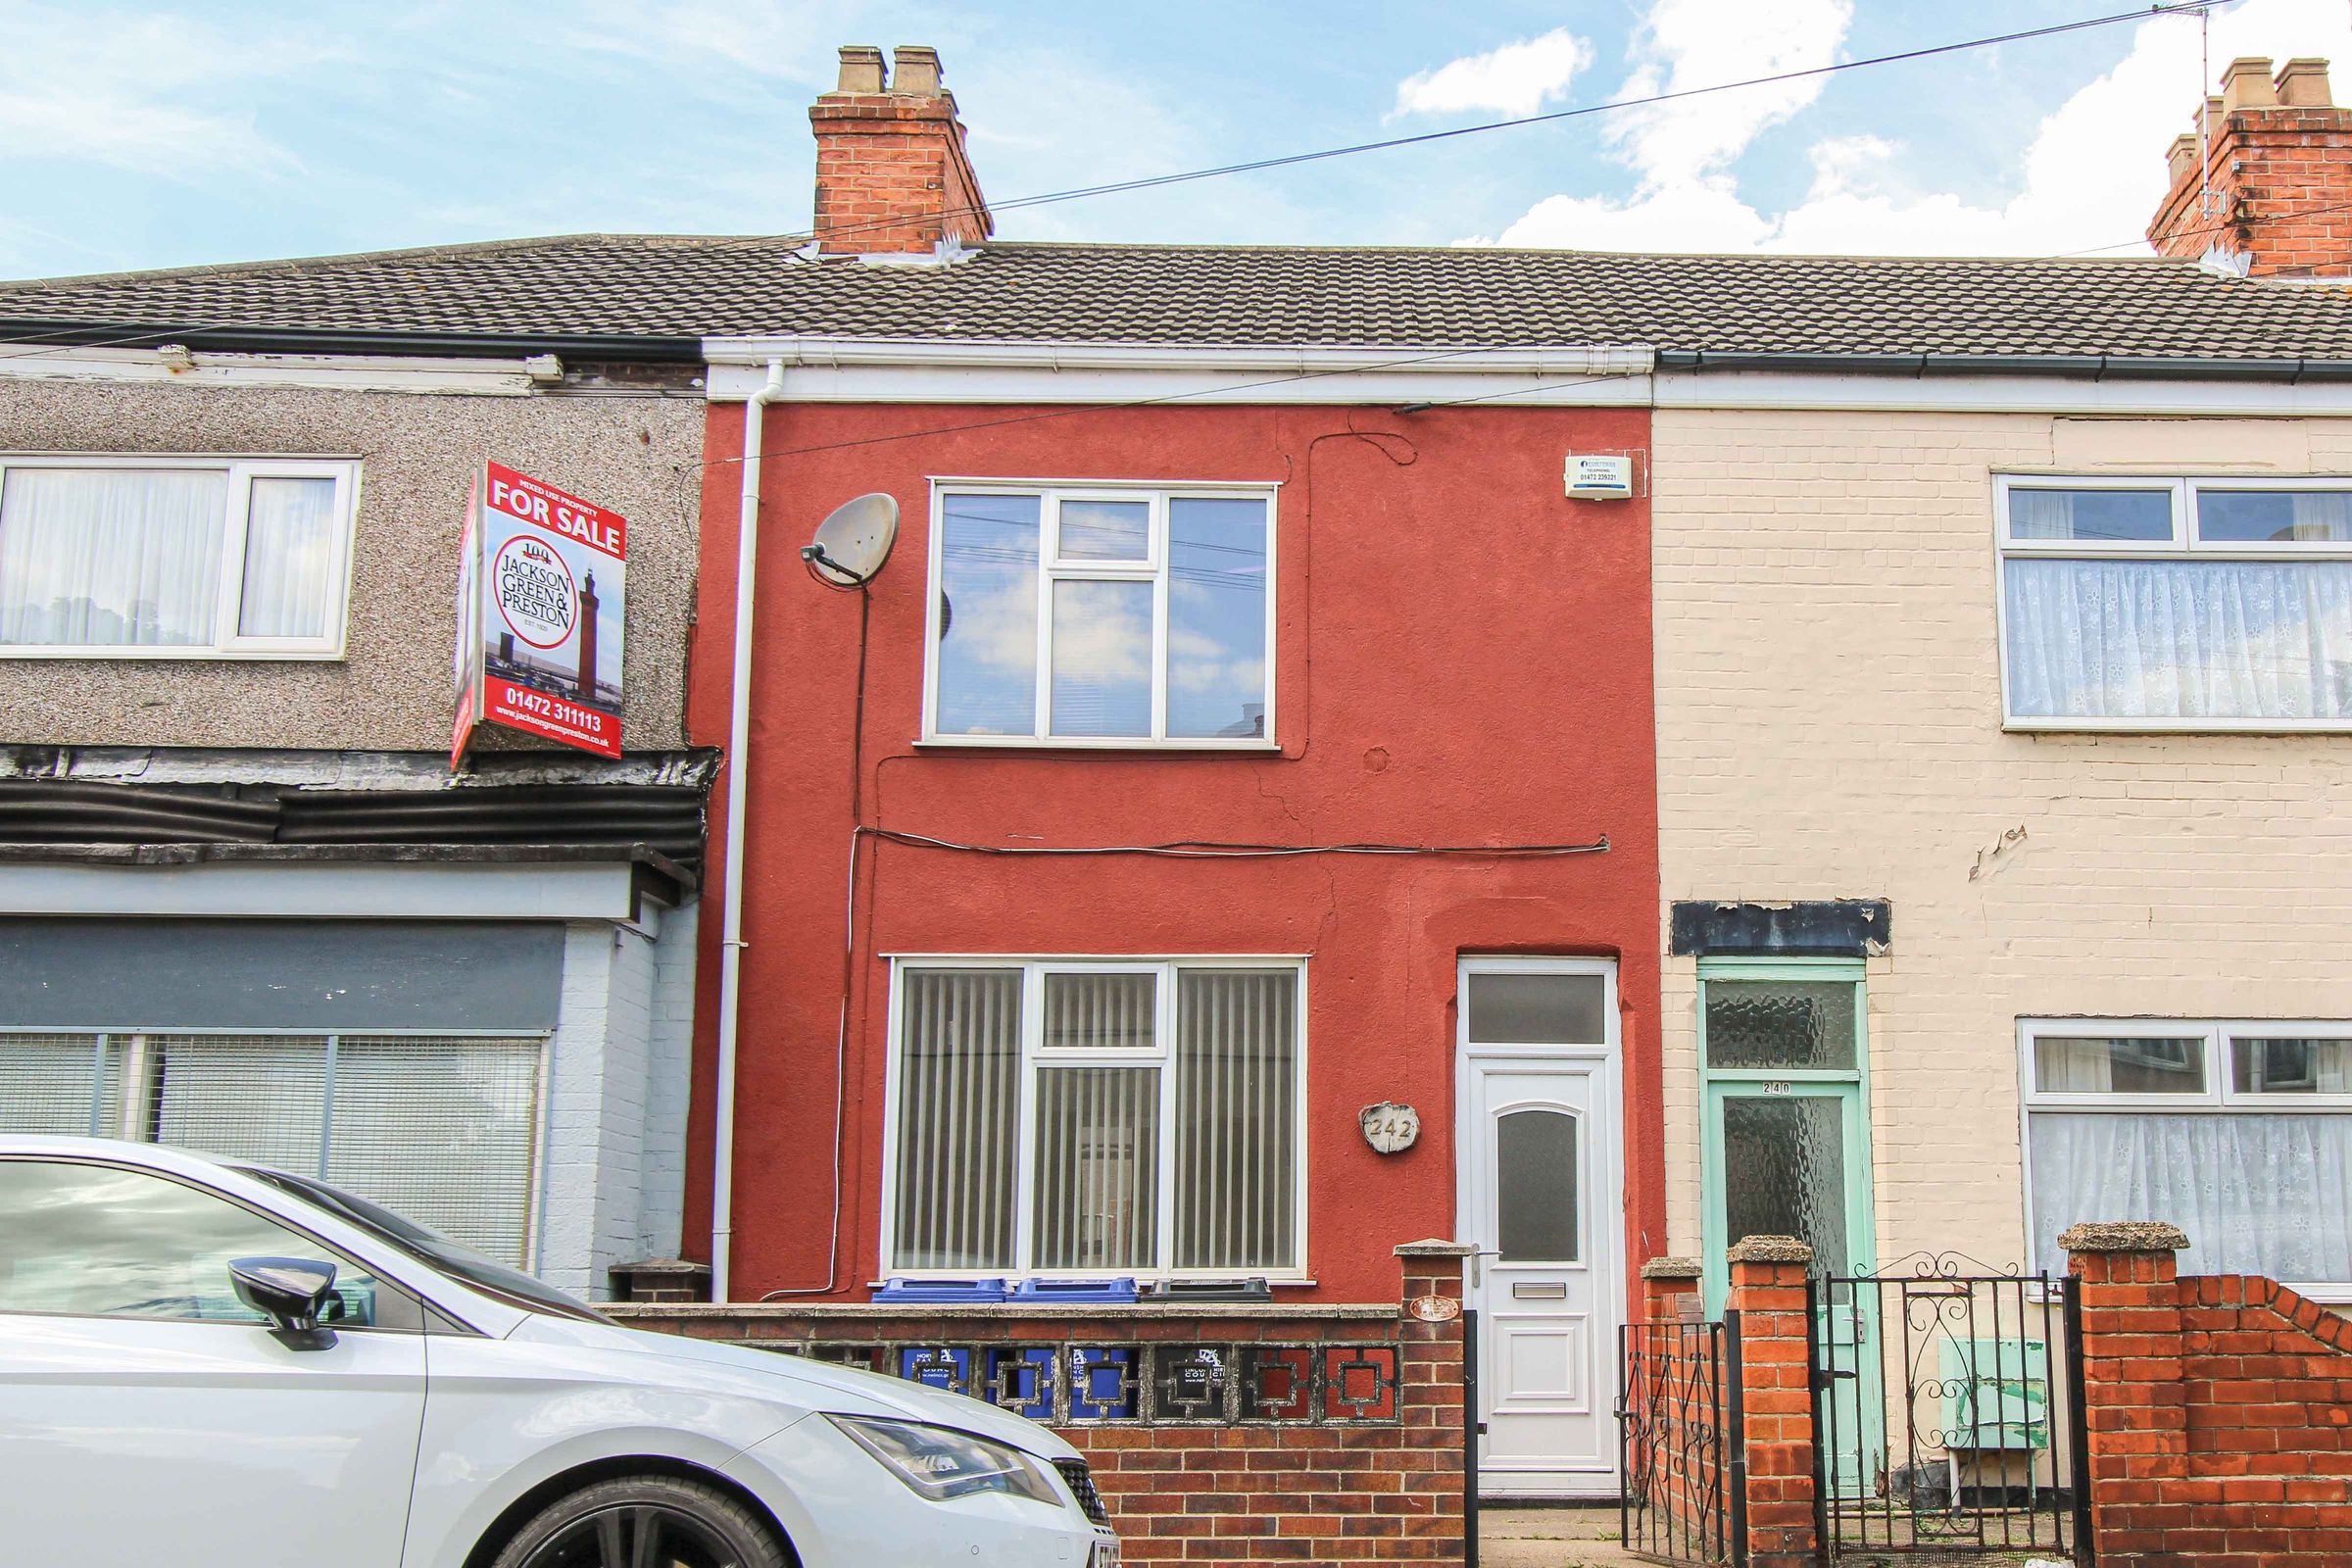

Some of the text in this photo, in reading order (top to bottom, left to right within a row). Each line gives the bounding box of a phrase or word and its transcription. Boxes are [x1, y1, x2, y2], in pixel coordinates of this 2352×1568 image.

[493, 479, 620, 555] FOR SALE
[518, 479, 598, 517] MIXED USE PROPERTY
[503, 555, 569, 594] JACKSON
[503, 573, 567, 612] GREEN &
[503, 590, 569, 630] PRESTON
[496, 706, 610, 748] www.jacksongreenpreston.co.uk
[507, 687, 602, 732] 01472 311113
[1764, 1083, 1789, 1093] 240
[1370, 1118, 1411, 1138] 242
